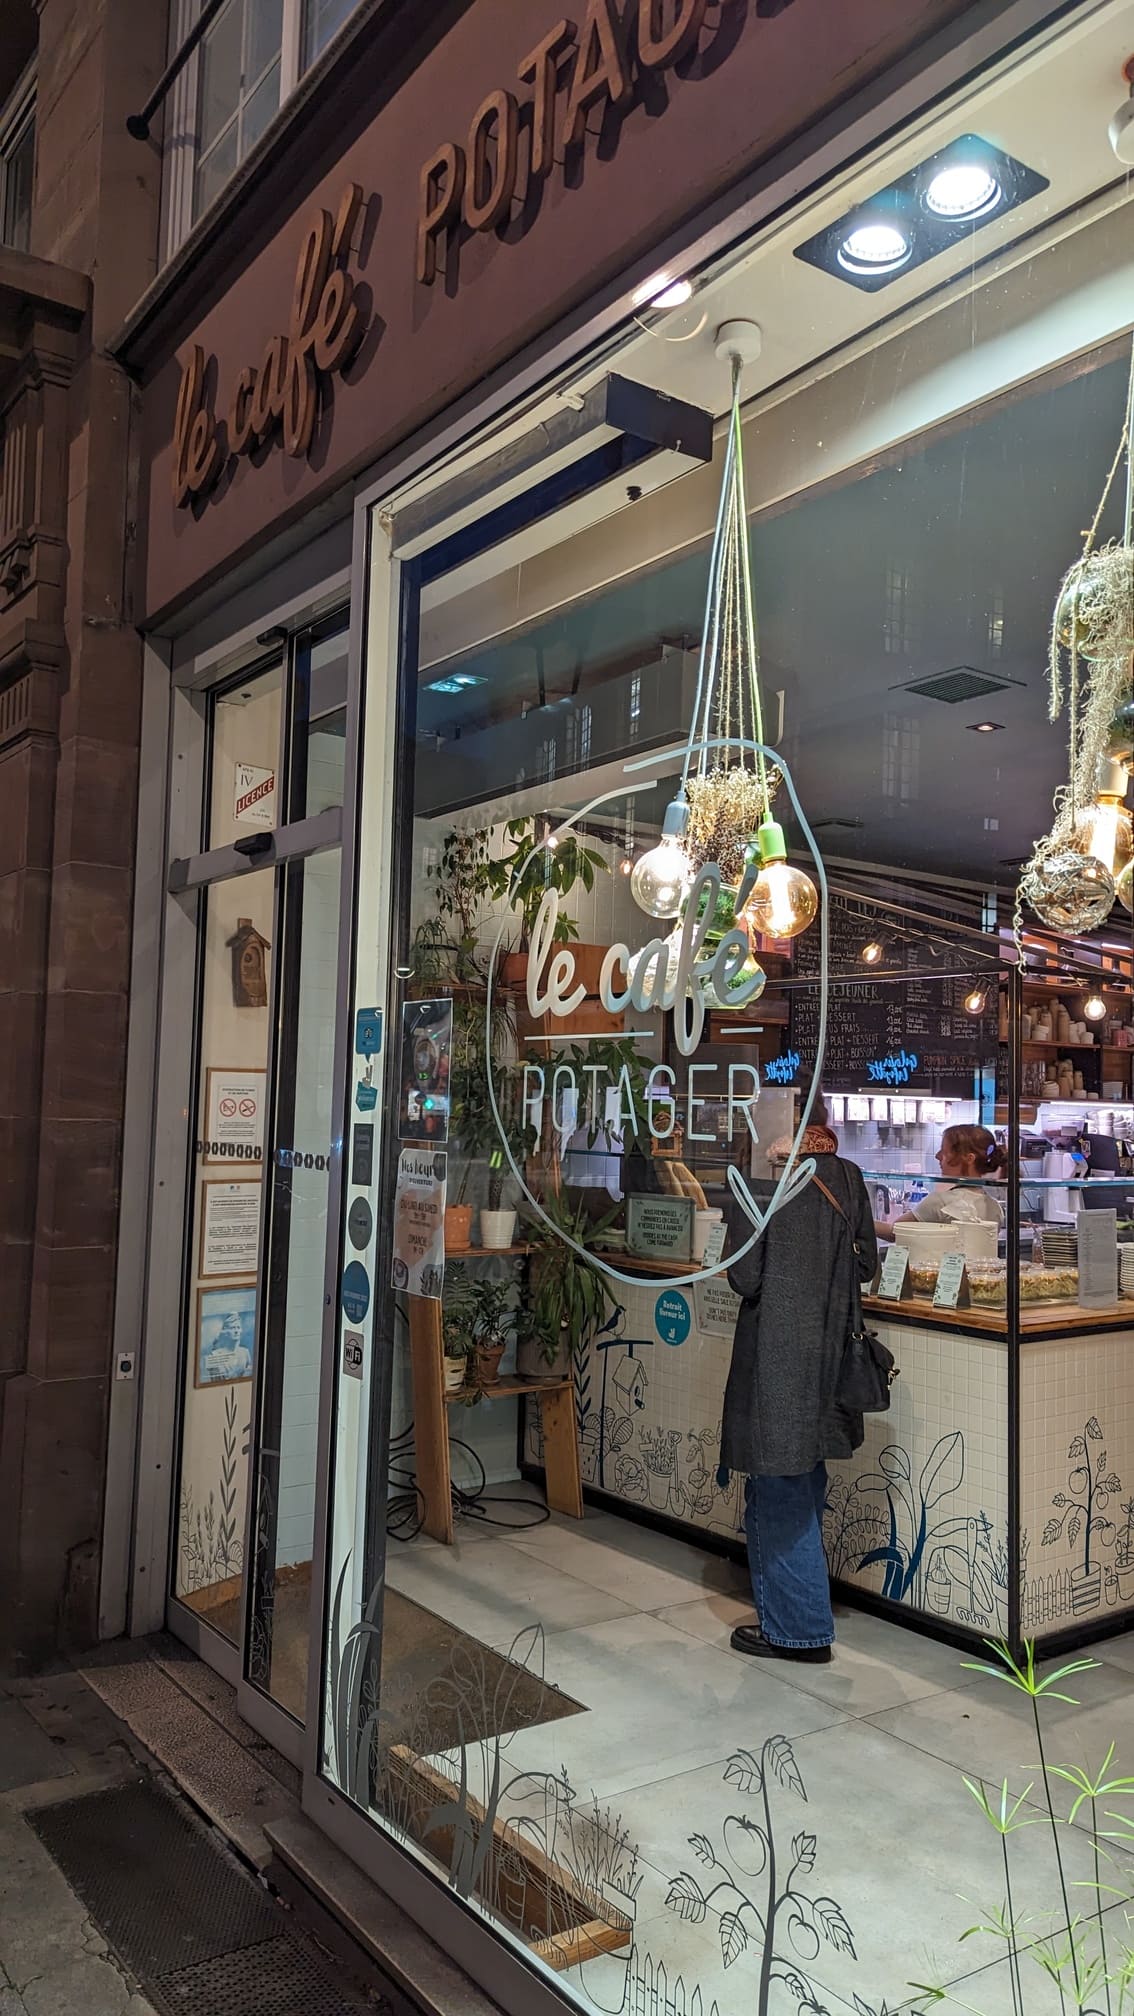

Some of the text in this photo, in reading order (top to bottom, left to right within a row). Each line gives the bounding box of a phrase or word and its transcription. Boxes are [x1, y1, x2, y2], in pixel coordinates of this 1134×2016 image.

[173, 344, 217, 509] le
[226, 183, 364, 458] café
[237, 778, 273, 812] LICENCE
[240, 774, 253, 786] IV
[525, 861, 768, 1057] le café
[521, 1063, 761, 1144] POTAGER
